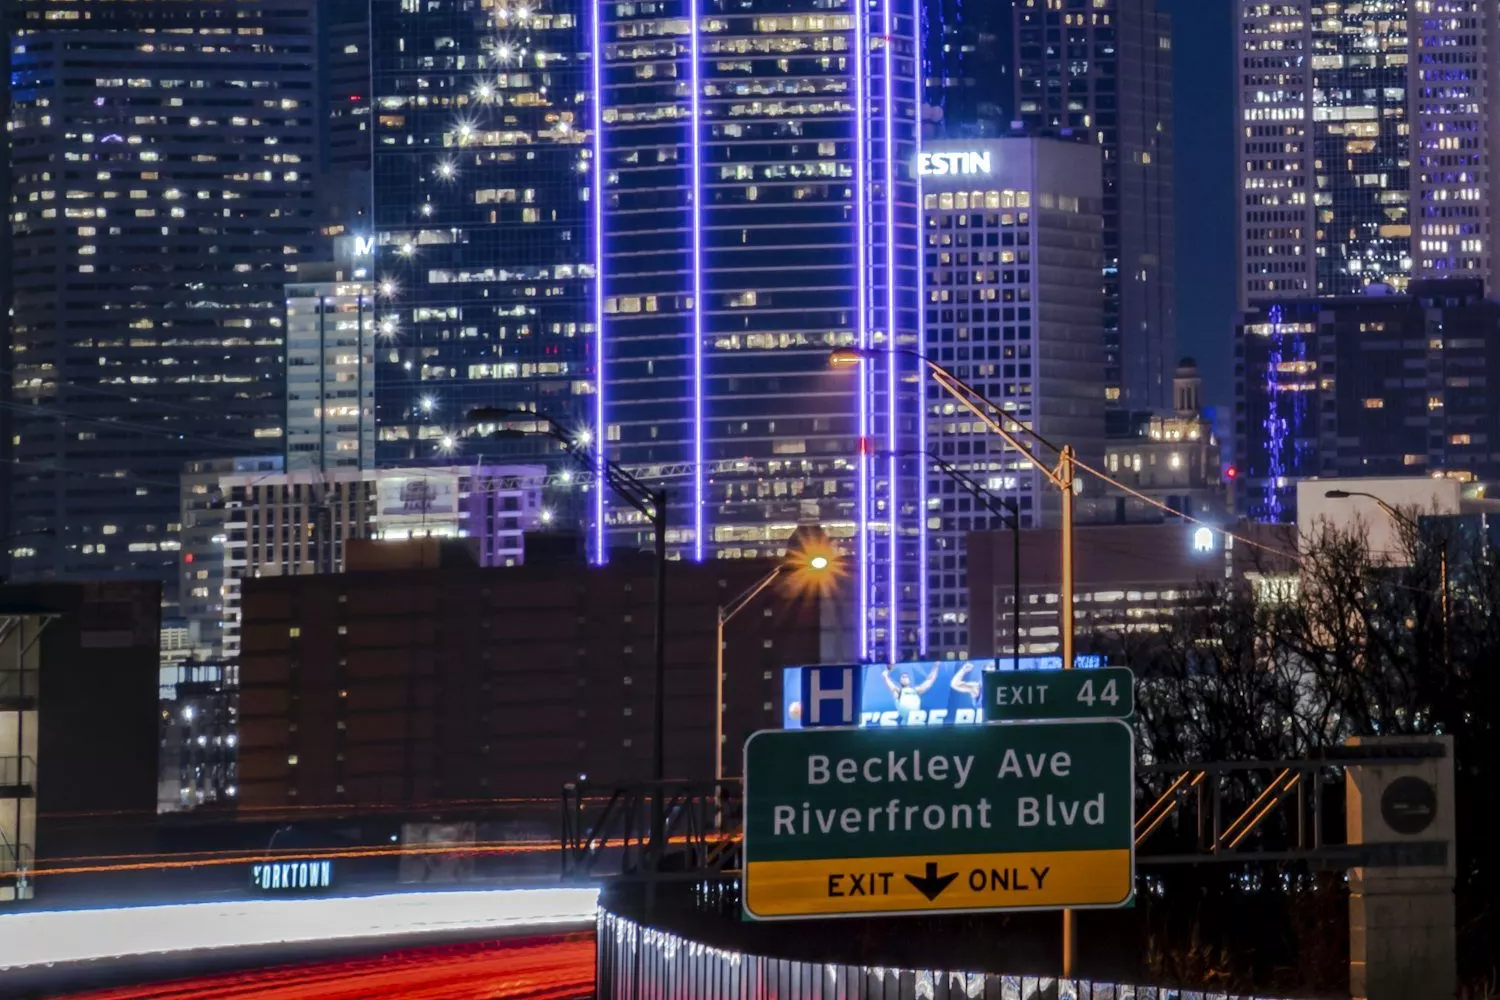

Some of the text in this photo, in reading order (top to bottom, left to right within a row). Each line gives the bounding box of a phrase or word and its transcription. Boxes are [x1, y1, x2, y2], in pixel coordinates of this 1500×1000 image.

[917, 151, 990, 175] ESTIN
[810, 669, 853, 723] H
[996, 680, 1120, 707] EXIT 44
[859, 711, 898, 727] T'S
[808, 749, 1072, 788] Beckley Ave
[774, 793, 1105, 835] Riverfront Blvd
[253, 861, 330, 889] YORKTOWN
[828, 867, 1050, 898] EXIT ONLY
